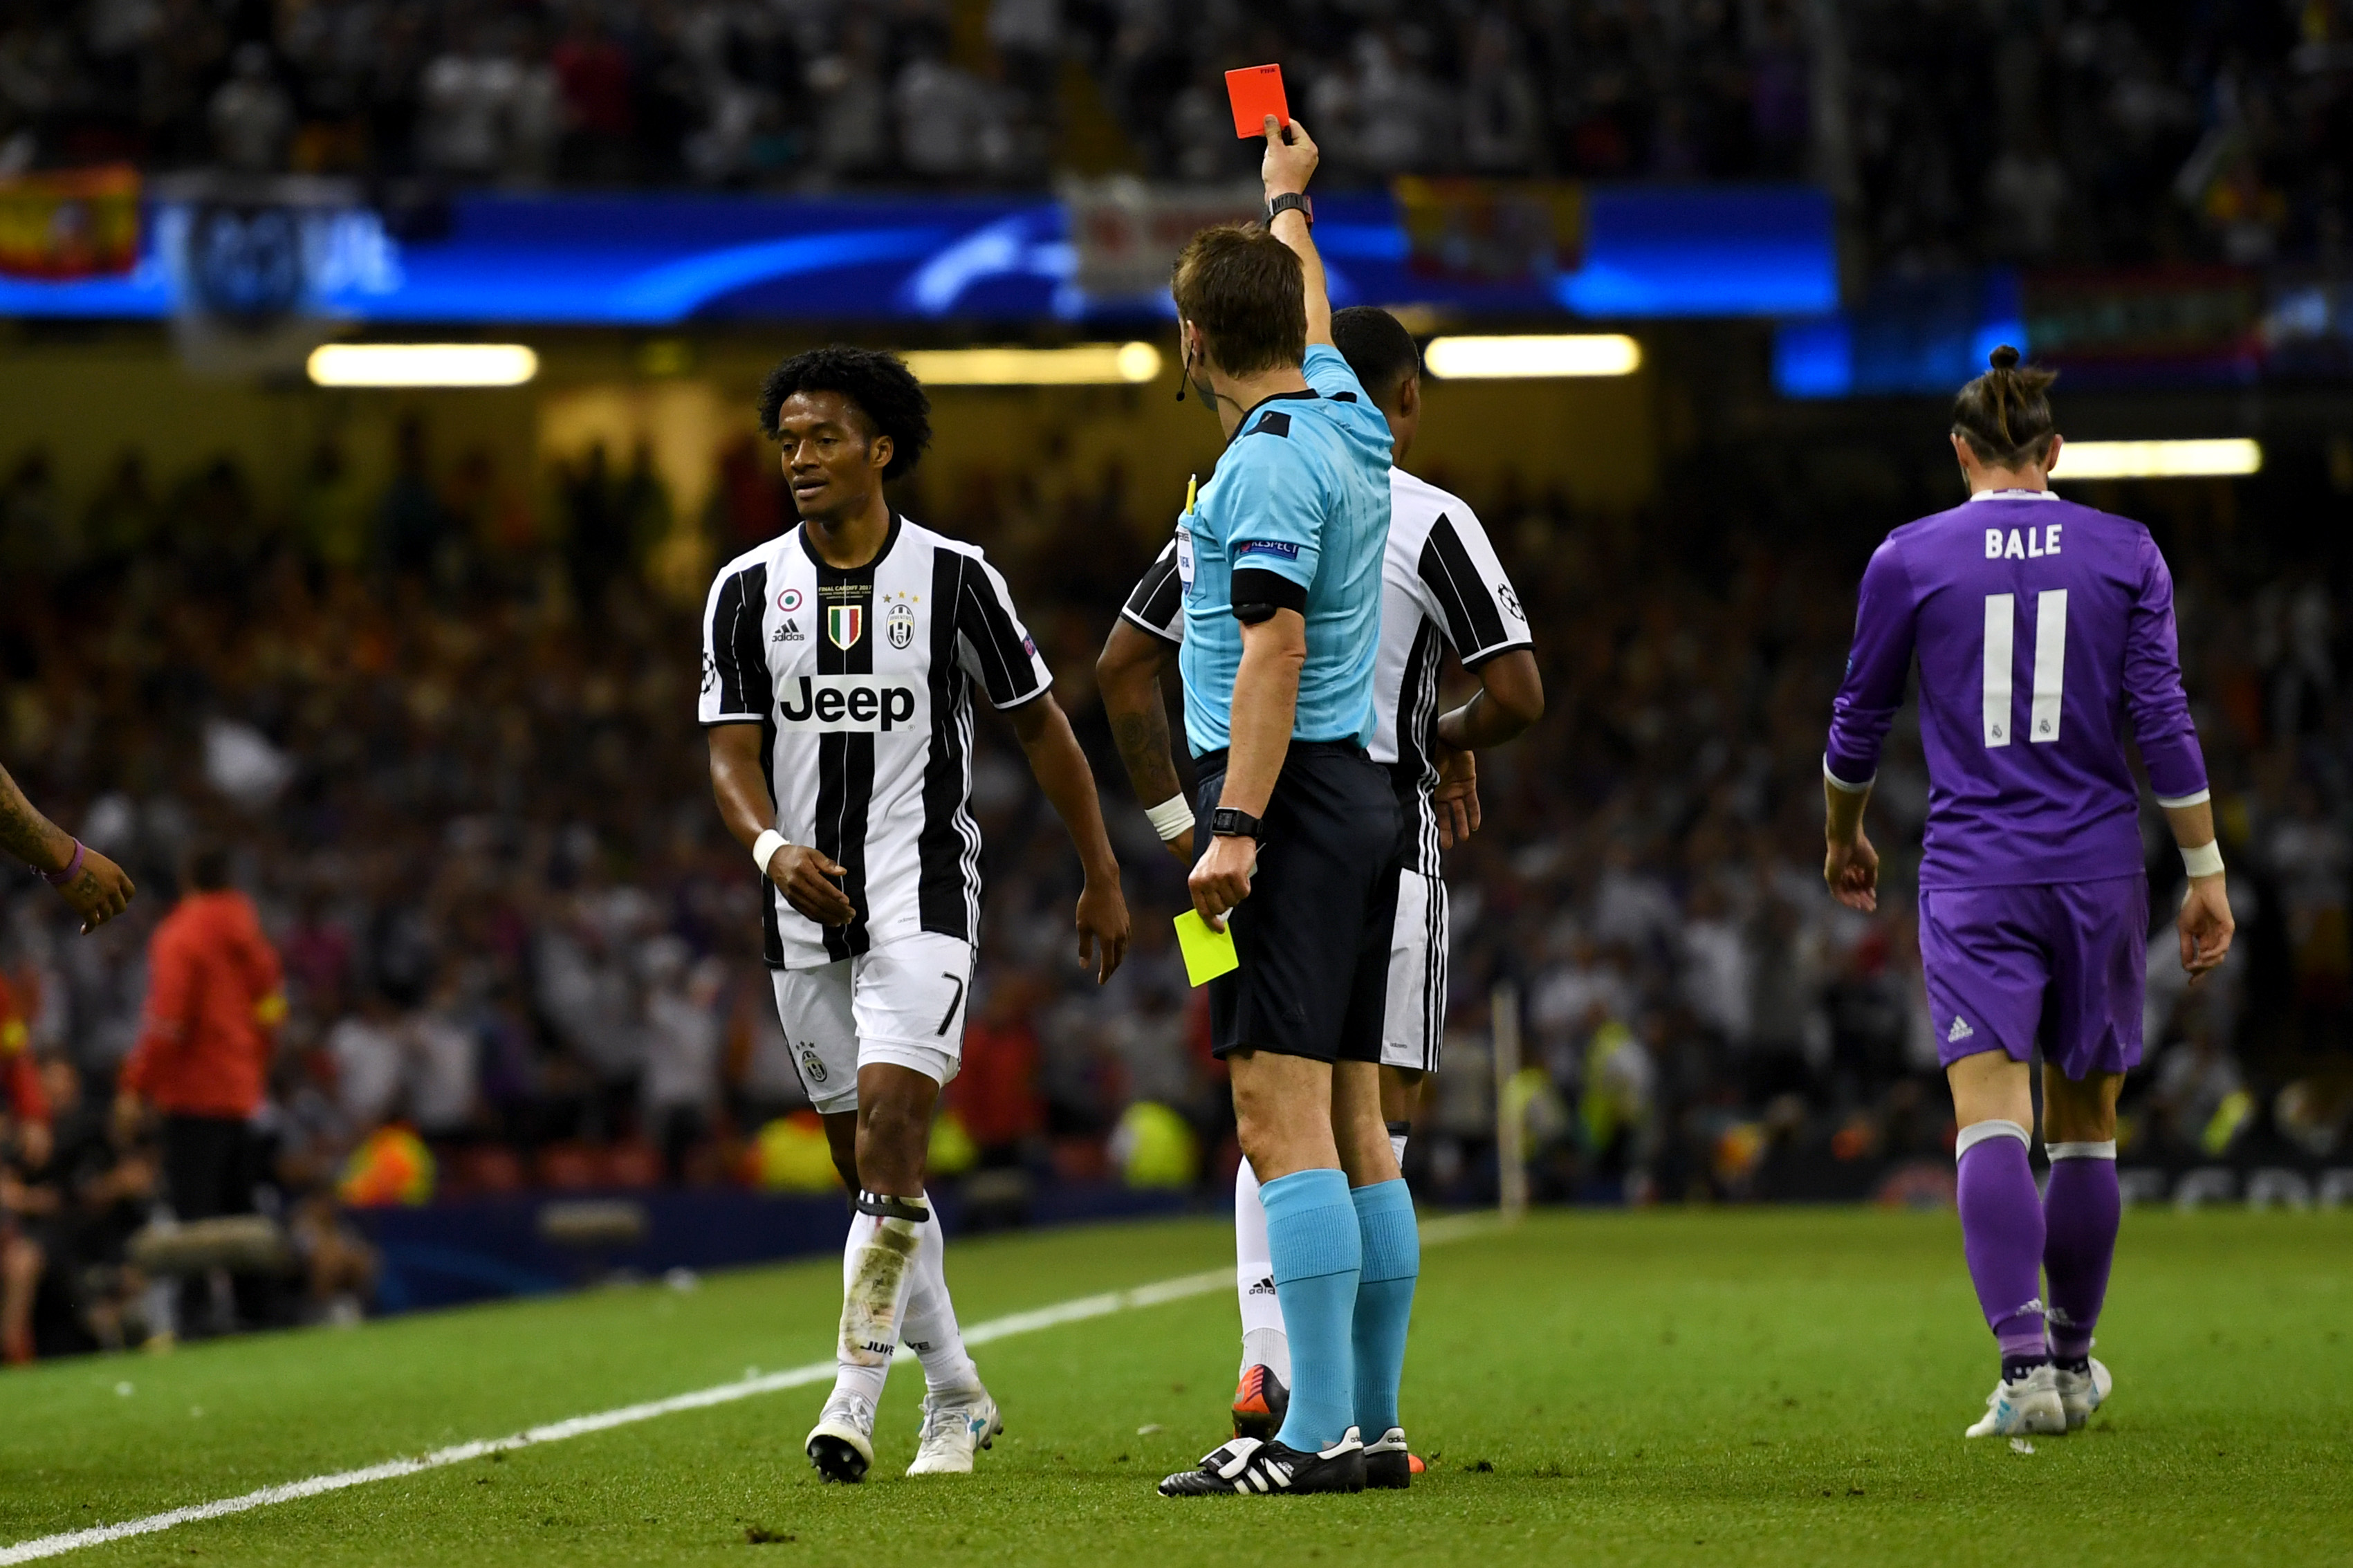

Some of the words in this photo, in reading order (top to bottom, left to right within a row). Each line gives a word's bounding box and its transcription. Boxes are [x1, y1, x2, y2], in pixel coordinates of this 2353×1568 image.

[1985, 524, 2063, 560] BALE
[771, 632, 805, 643] adidas
[1982, 589, 2068, 748] 11
[779, 675, 915, 732] Jeep
[934, 970, 963, 1037] 7
[1248, 1286, 1276, 1295] adid
[859, 1340, 896, 1357] JUVE
